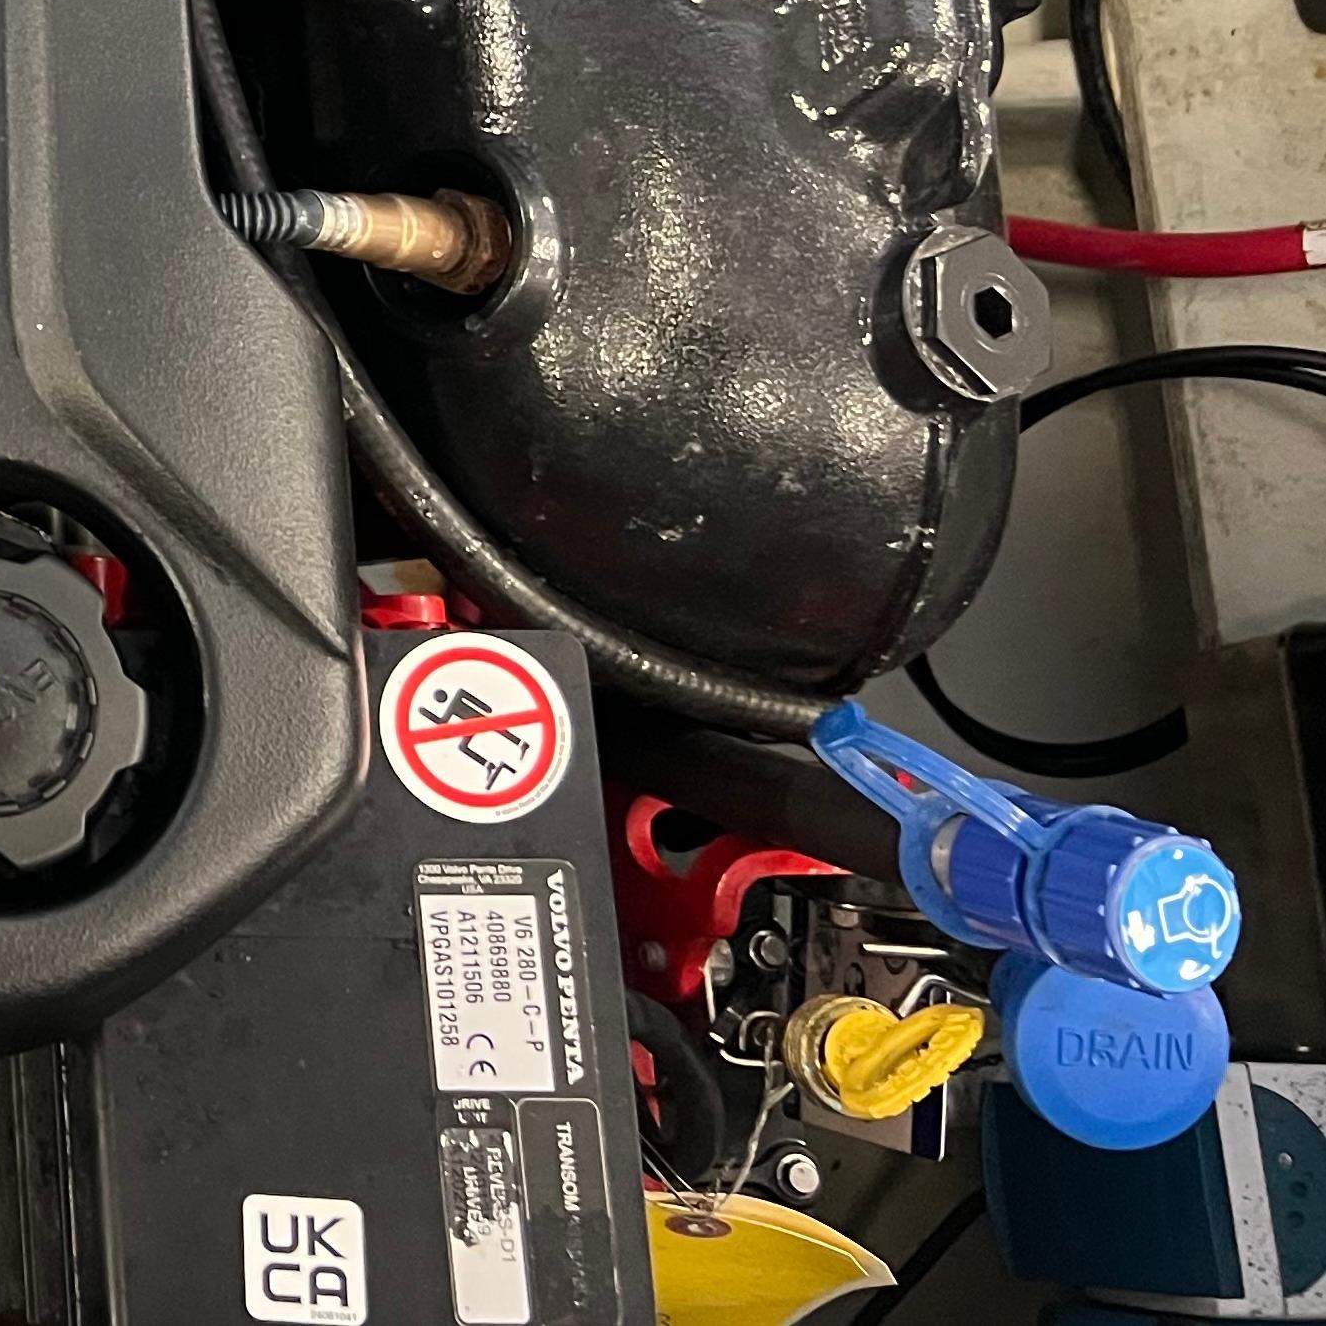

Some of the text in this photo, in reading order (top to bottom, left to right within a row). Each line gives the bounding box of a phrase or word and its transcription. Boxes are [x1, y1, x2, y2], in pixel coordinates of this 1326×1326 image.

[457, 910, 485, 1004] A1211506
[486, 910, 512, 1003] 40869880
[514, 915, 534, 939] V6
[430, 910, 460, 1047] VPGAS101258
[547, 869, 585, 1086] VOLVO PENTA
[1057, 1026, 1194, 1072] DRAIN
[555, 1120, 582, 1212] TRANSOM
[260, 1212, 347, 1260] UK
[262, 1263, 349, 1308] CA
